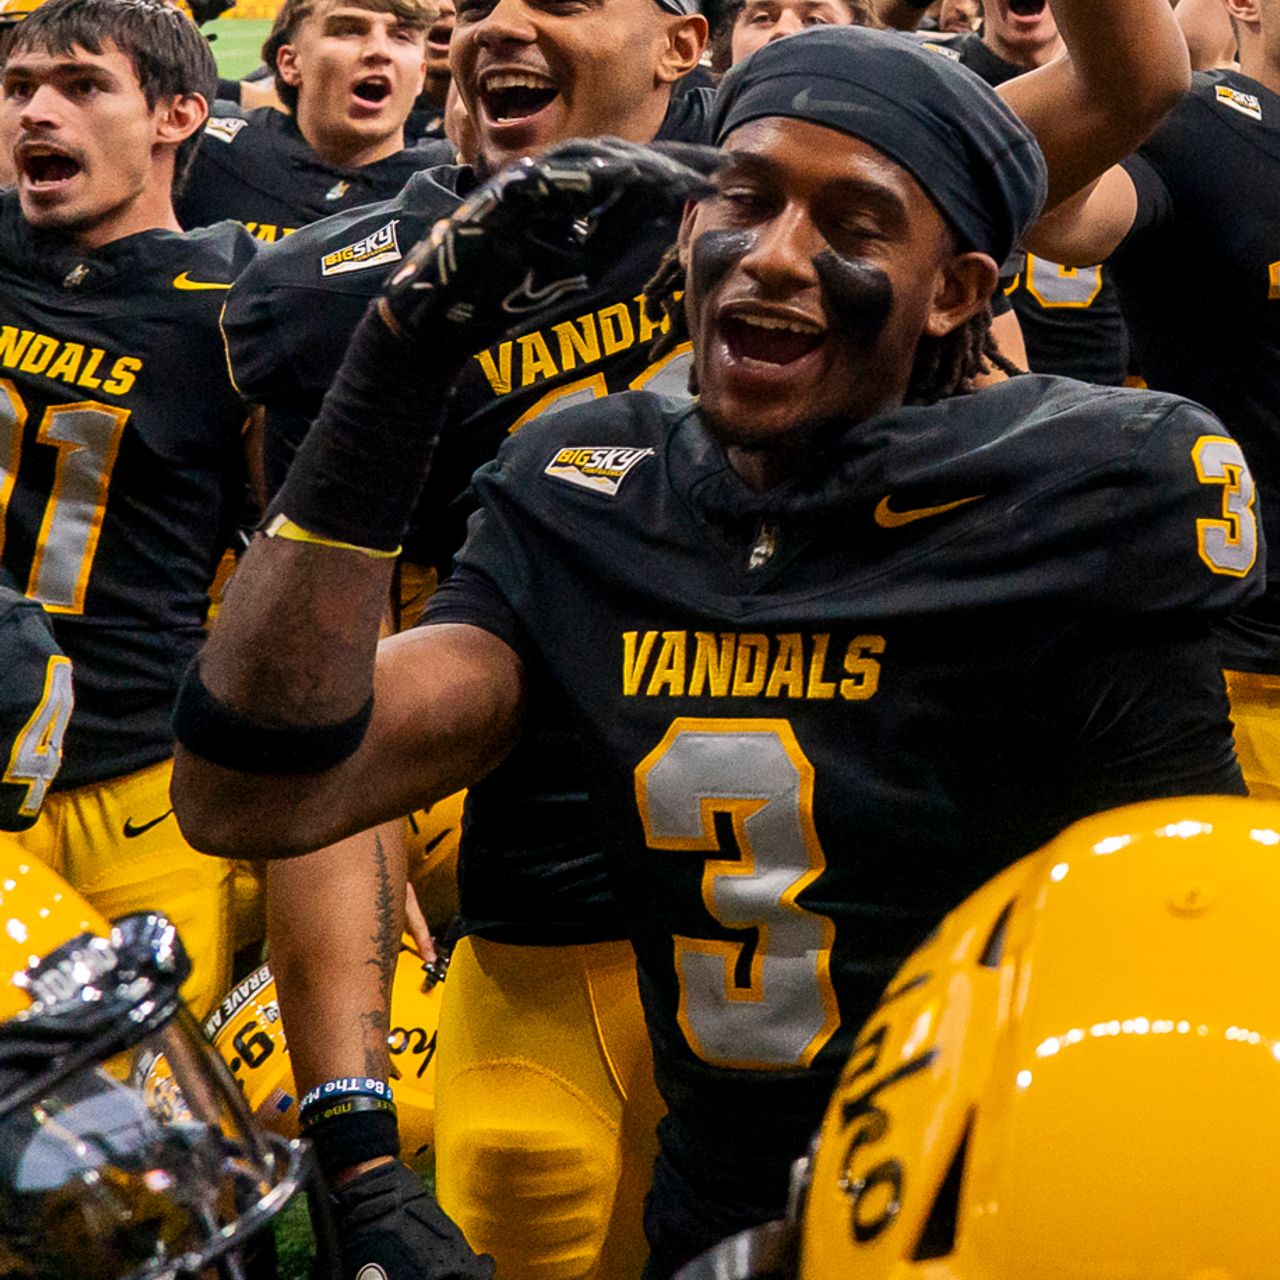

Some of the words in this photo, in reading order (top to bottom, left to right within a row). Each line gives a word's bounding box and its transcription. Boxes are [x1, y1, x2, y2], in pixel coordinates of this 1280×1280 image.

[0, 324, 144, 396] NDALS
[0, 377, 132, 615] 1
[1191, 434, 1258, 579] 3
[621, 630, 888, 703] VANDALS
[633, 716, 842, 1072] 3
[222, 964, 271, 1017] BRAVE
[324, 1078, 361, 1093] The
[365, 1078, 386, 1095] Be
